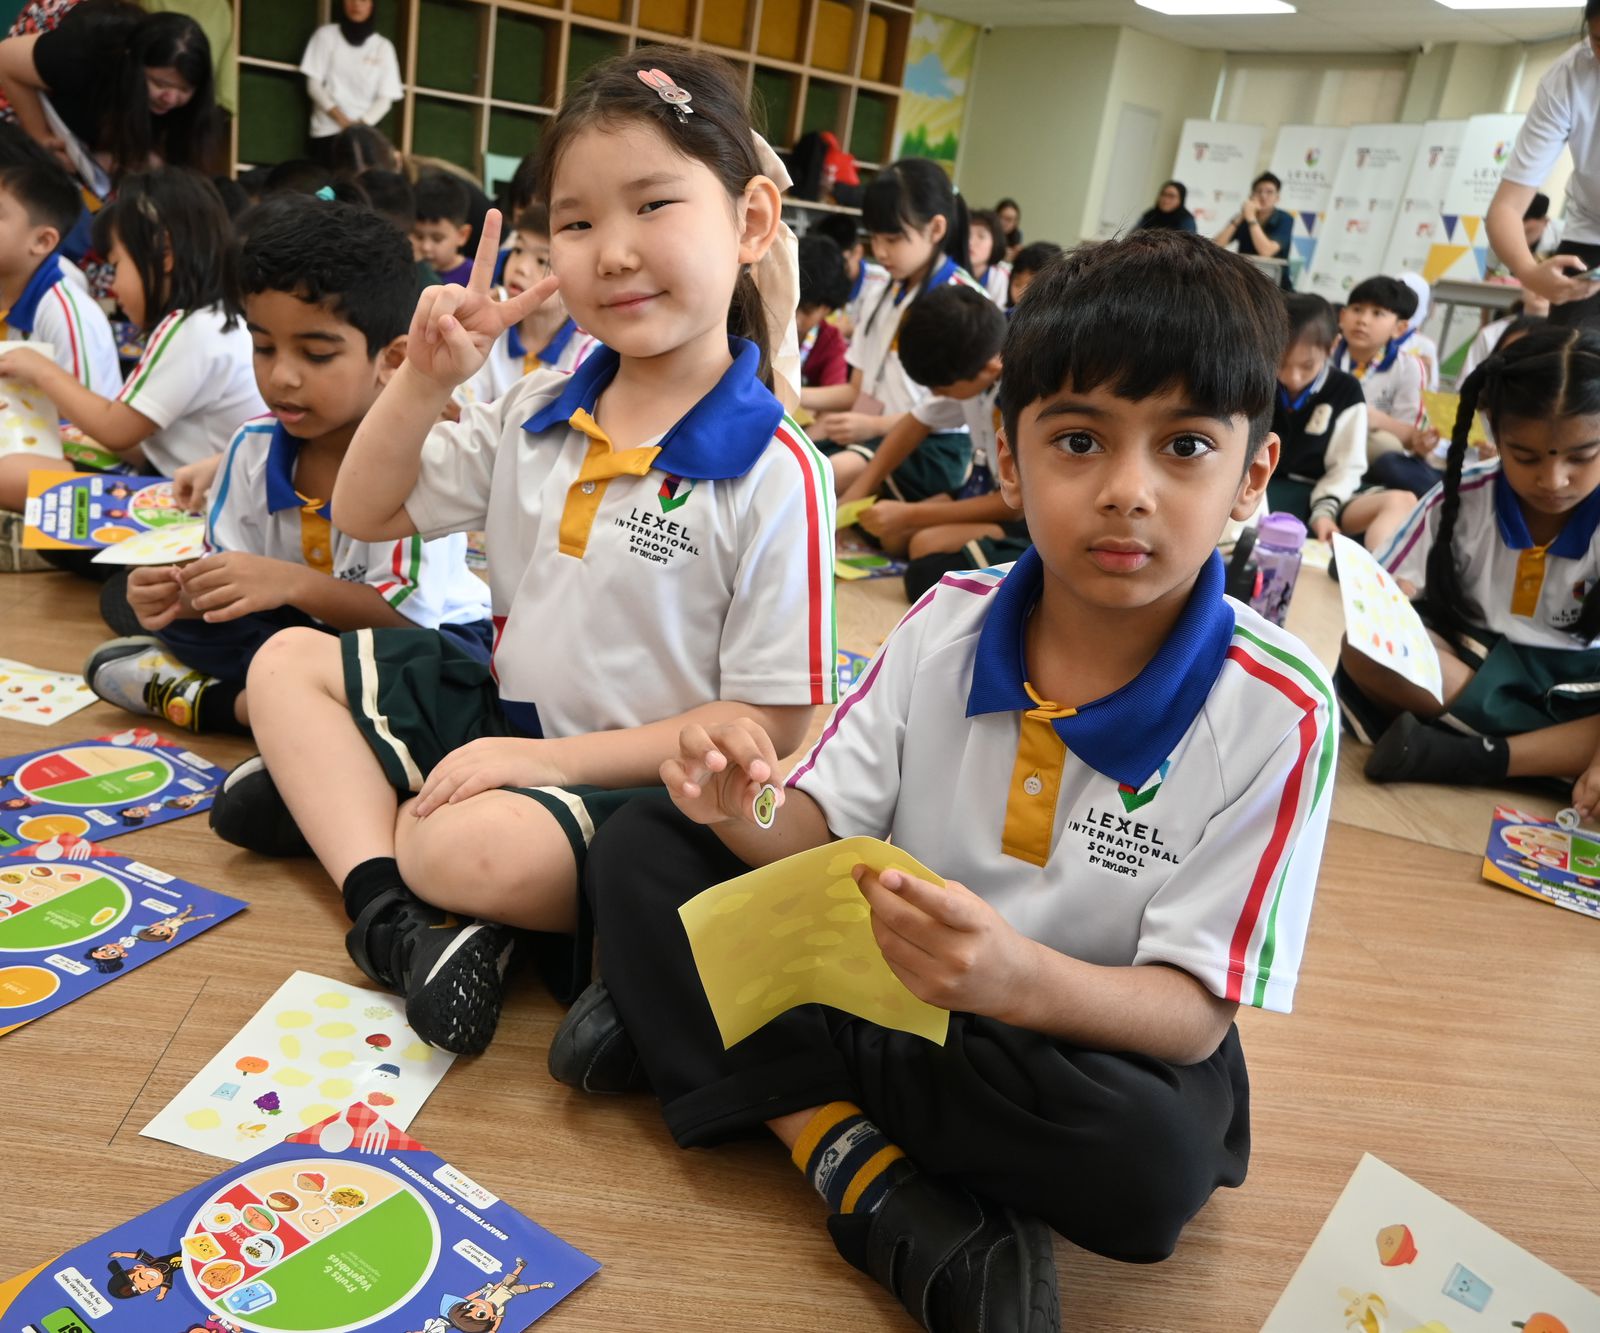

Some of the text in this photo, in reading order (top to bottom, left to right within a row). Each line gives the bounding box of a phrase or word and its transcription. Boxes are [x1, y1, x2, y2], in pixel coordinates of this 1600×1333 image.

[630, 507, 690, 541] LEXEL
[614, 518, 700, 556] INTERNATIONAL
[629, 535, 674, 557] SCHOOL
[629, 545, 668, 565] BY TAYLOR'S
[1086, 807, 1164, 846] LEXEL
[1068, 820, 1180, 865] INTERNATIONAL
[1087, 841, 1145, 868] SCHOOL
[1089, 855, 1138, 878] BY TAYLOR'S
[455, 1203, 509, 1241] #HAPPYDINERS
[322, 1263, 333, 1274] &
[327, 1253, 372, 1292] Vegetables
[68, 1282, 83, 1297] Protein
[330, 1269, 358, 1293] Fruits
[87, 1290, 95, 1299] big
[93, 1296, 101, 1305] my
